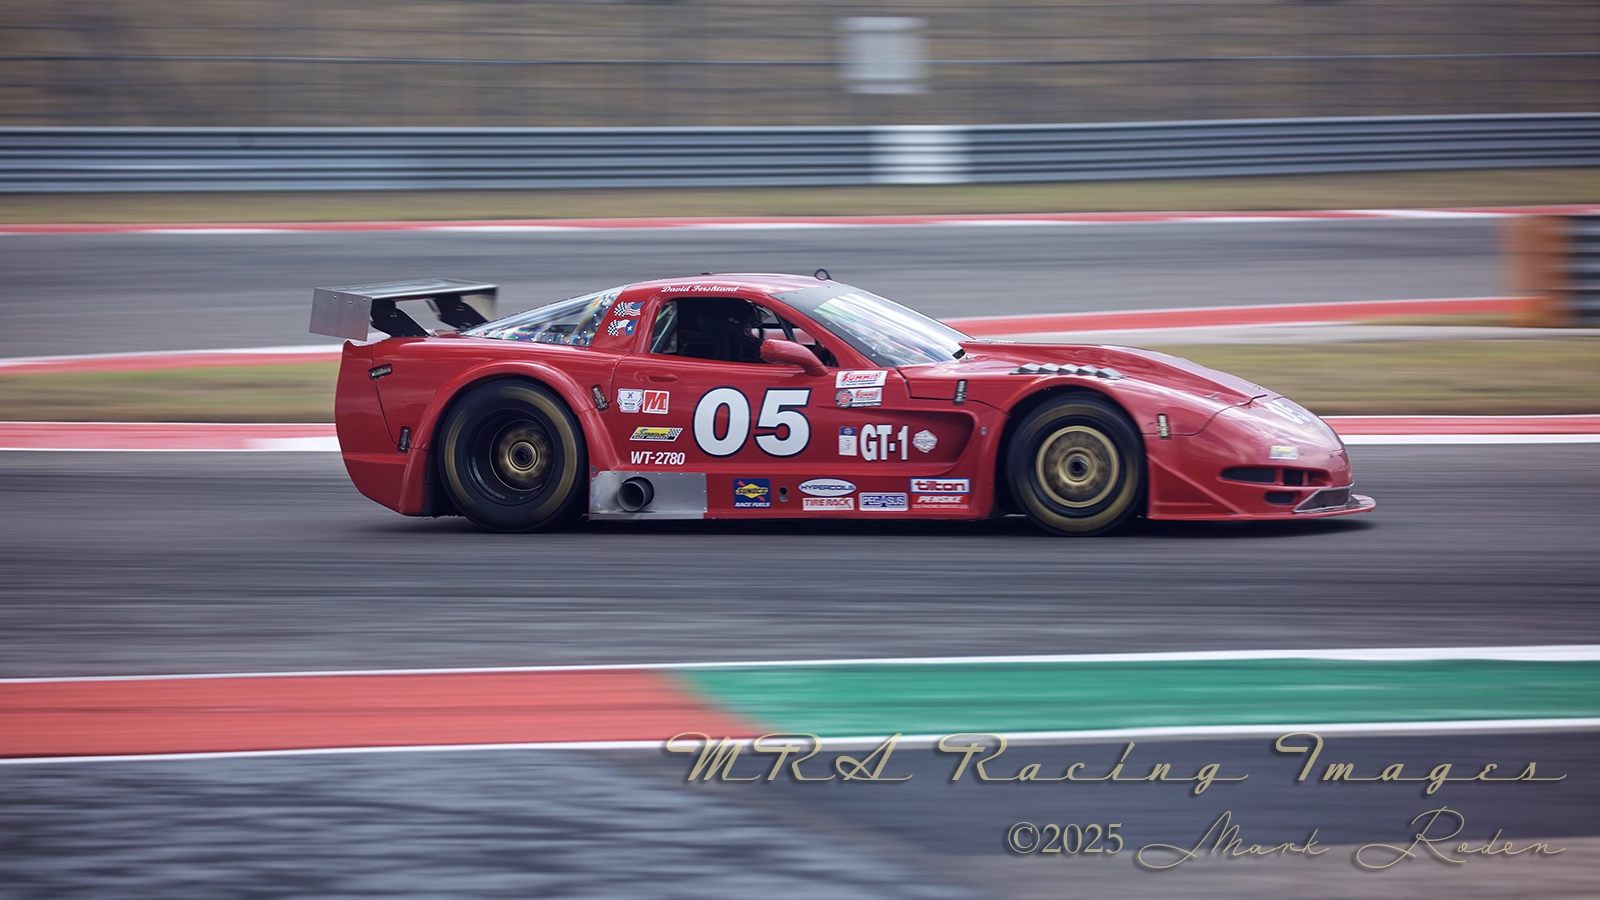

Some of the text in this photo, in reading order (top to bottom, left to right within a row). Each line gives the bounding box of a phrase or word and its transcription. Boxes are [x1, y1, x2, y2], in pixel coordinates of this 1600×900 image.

[660, 285, 691, 293] David
[691, 385, 813, 459] 05
[859, 423, 909, 462] GT-1
[630, 450, 686, 466] WT-2780
[735, 486, 769, 496] SUNOCO
[825, 497, 852, 509] RACK
[863, 494, 905, 506] PEGASUS
[917, 495, 964, 503] PENSKE
